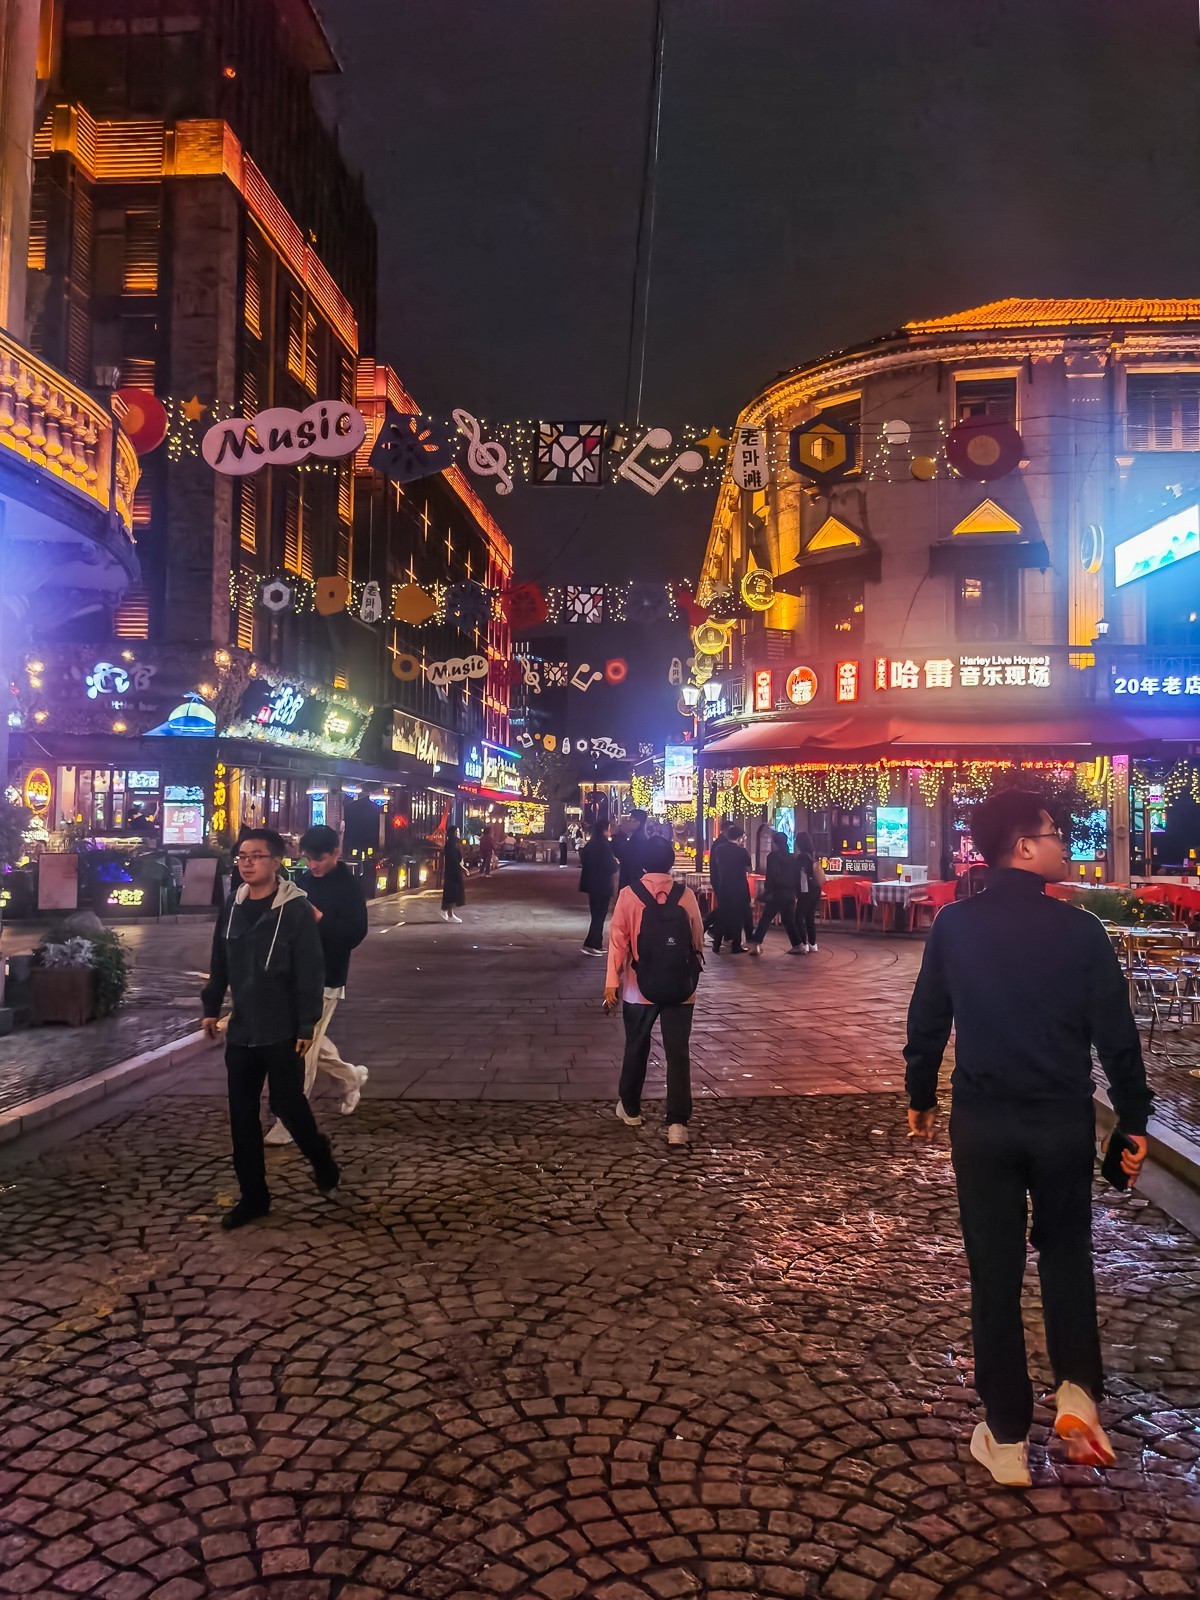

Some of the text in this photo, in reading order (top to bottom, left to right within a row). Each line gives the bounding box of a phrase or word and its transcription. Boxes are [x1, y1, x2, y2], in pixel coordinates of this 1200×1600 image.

[215, 408, 352, 465] Music
[432, 658, 484, 681] Music
[960, 656, 991, 667] Harley
[992, 655, 1012, 665] Live
[890, 659, 955, 688] 哈雷
[960, 666, 1051, 687] 音乐现场
[1114, 675, 1200, 696] 20年老店
